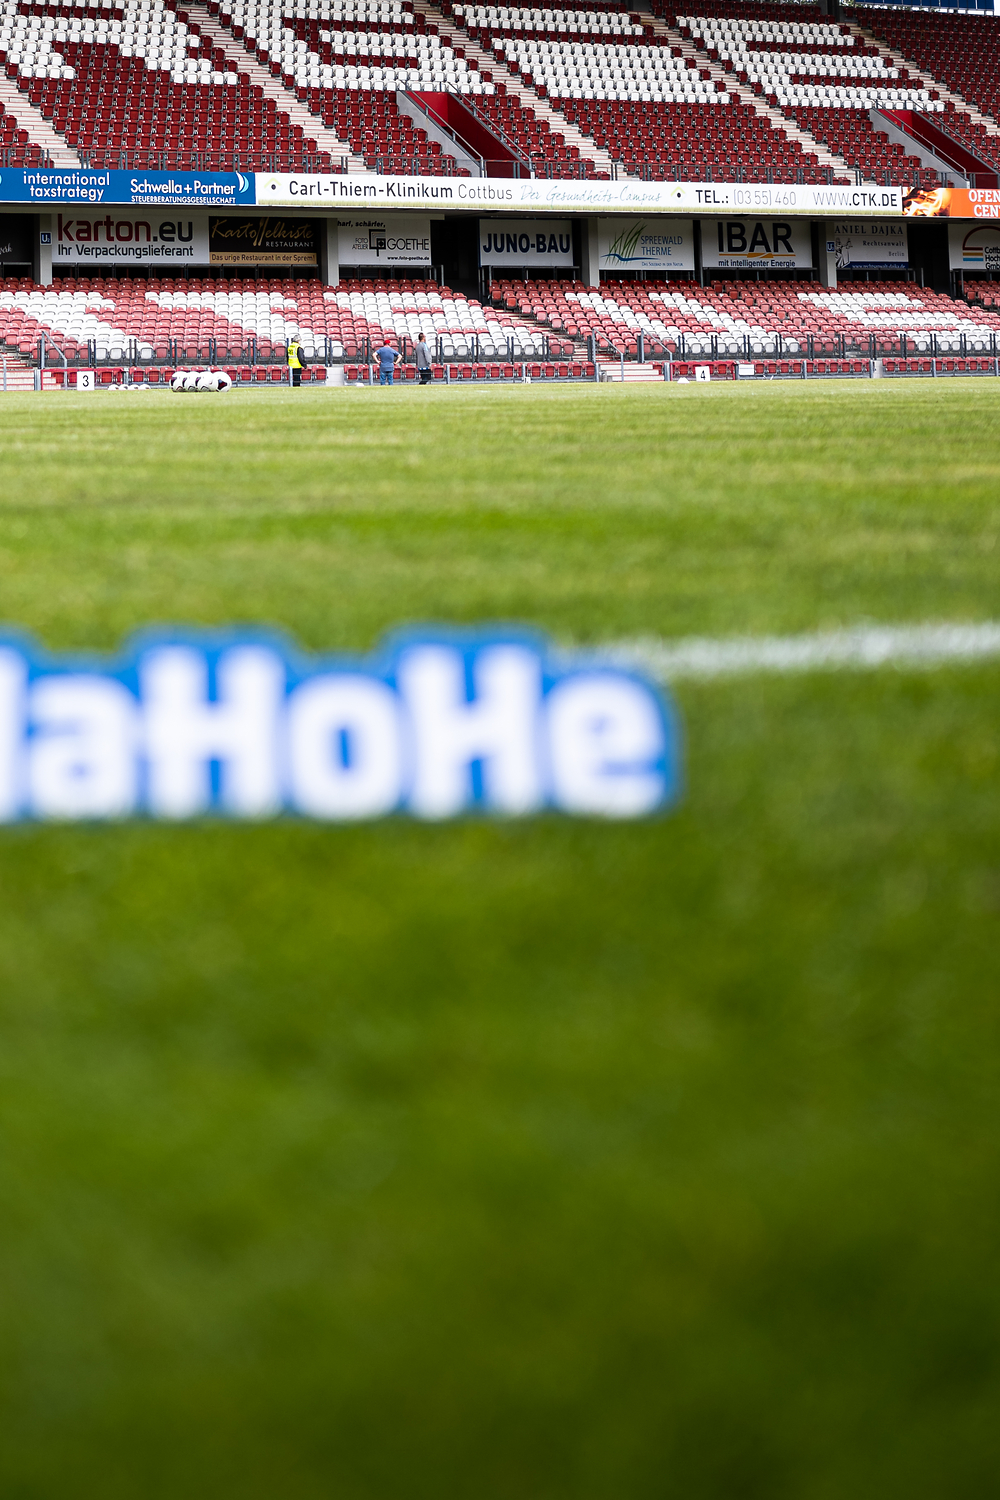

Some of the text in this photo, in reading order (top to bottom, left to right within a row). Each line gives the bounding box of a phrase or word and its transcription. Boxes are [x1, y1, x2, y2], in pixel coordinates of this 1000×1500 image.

[23, 171, 110, 186] international
[30, 185, 104, 202] taxstrategy
[130, 178, 182, 194] Schwella
[194, 180, 236, 195] Partner
[458, 184, 513, 200] Cottbus
[131, 195, 236, 204] STEUERBERATUNGSGESELLSCHAFT
[695, 189, 729, 204] TEL.:
[774, 191, 797, 206] 460
[812, 191, 898, 207] WWW.CTK.DE
[973, 204, 1000, 217] CEN
[57, 213, 194, 242] karton.eu
[871, 225, 904, 236] DAJKA
[387, 238, 429, 250] GOETHE
[483, 233, 571, 254] JUNO-BAU
[640, 235, 683, 245] SPREEWALD
[717, 221, 794, 253] IBAR
[58, 244, 194, 259] Ihr Verpackungslieferant
[641, 246, 672, 256] THERME
[731, 260, 769, 268] intelligenter
[771, 260, 796, 268] Energie
[82, 375, 89, 387] 3
[700, 370, 706, 381] 4
